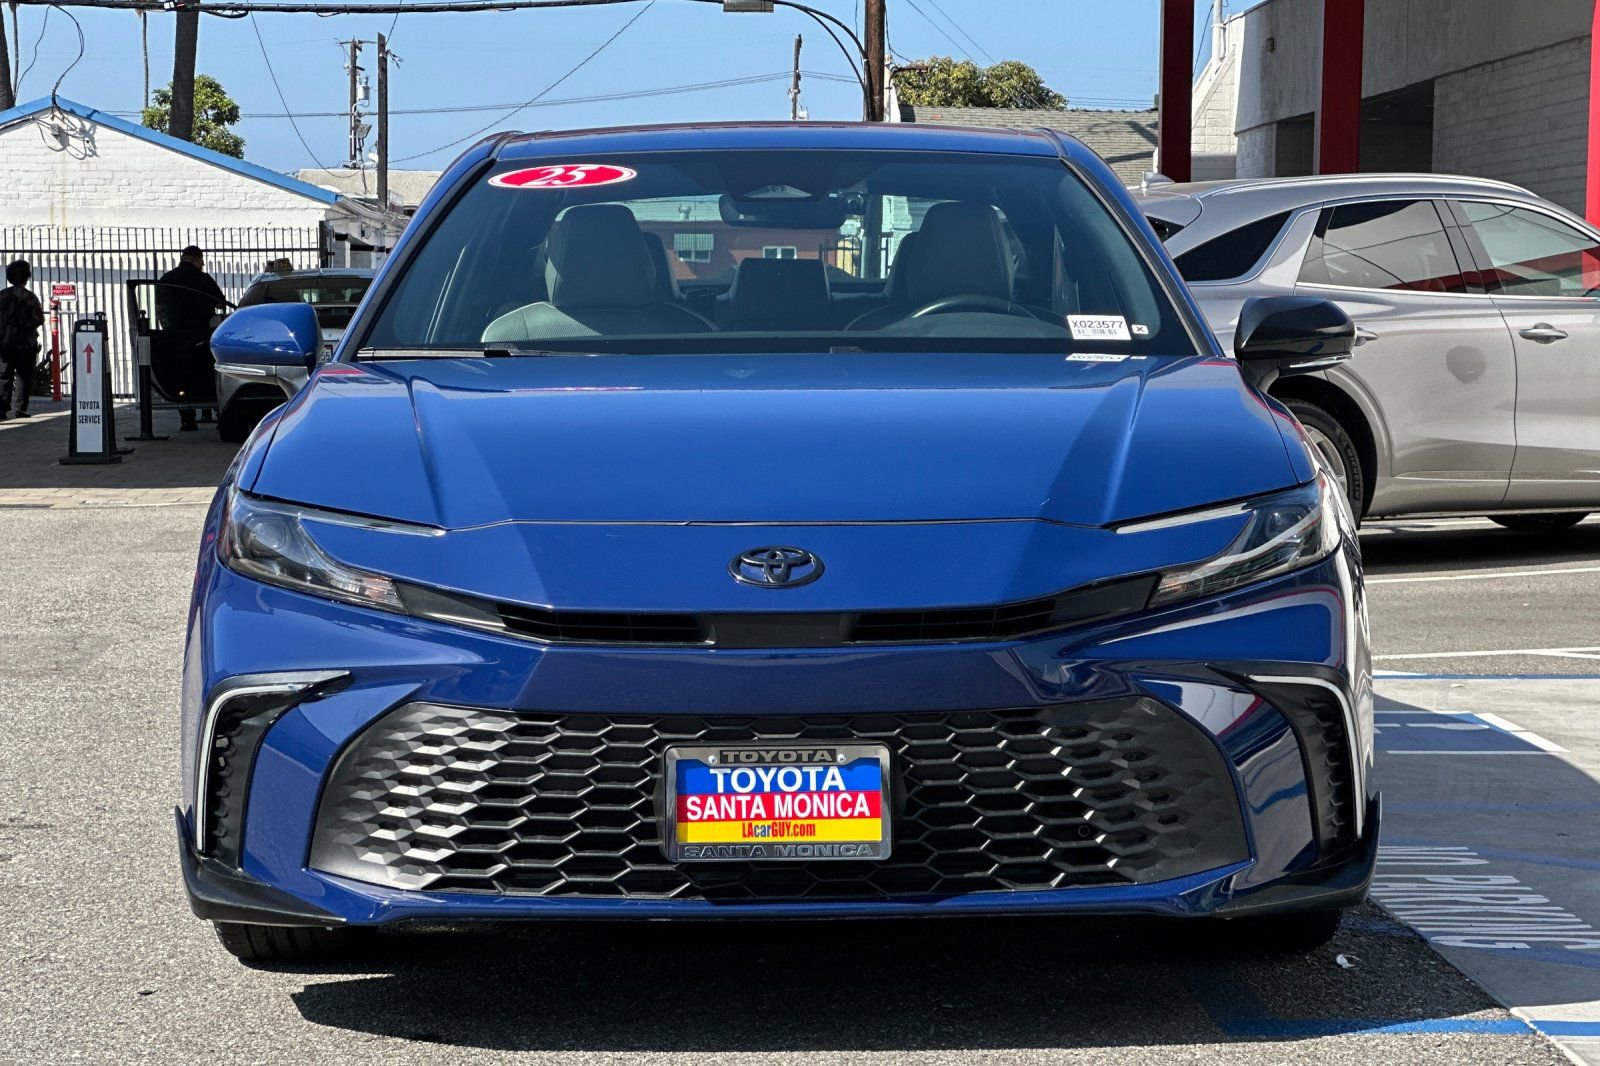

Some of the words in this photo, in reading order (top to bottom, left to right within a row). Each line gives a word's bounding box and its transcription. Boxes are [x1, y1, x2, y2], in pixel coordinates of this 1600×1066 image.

[520, 166, 600, 186] 25
[1072, 320, 1123, 329] X023577
[1136, 325, 1145, 333] X
[79, 400, 100, 410] TOYOTA
[78, 414, 101, 424] SERVICE
[722, 749, 833, 763] TOYOTA
[709, 766, 847, 793] TOYOTA
[686, 795, 767, 821] SANTA
[774, 793, 871, 818] MONICA
[742, 821, 816, 839] LAcarGUY.com
[684, 845, 768, 858] SANTA
[775, 843, 874, 857] MONICA
